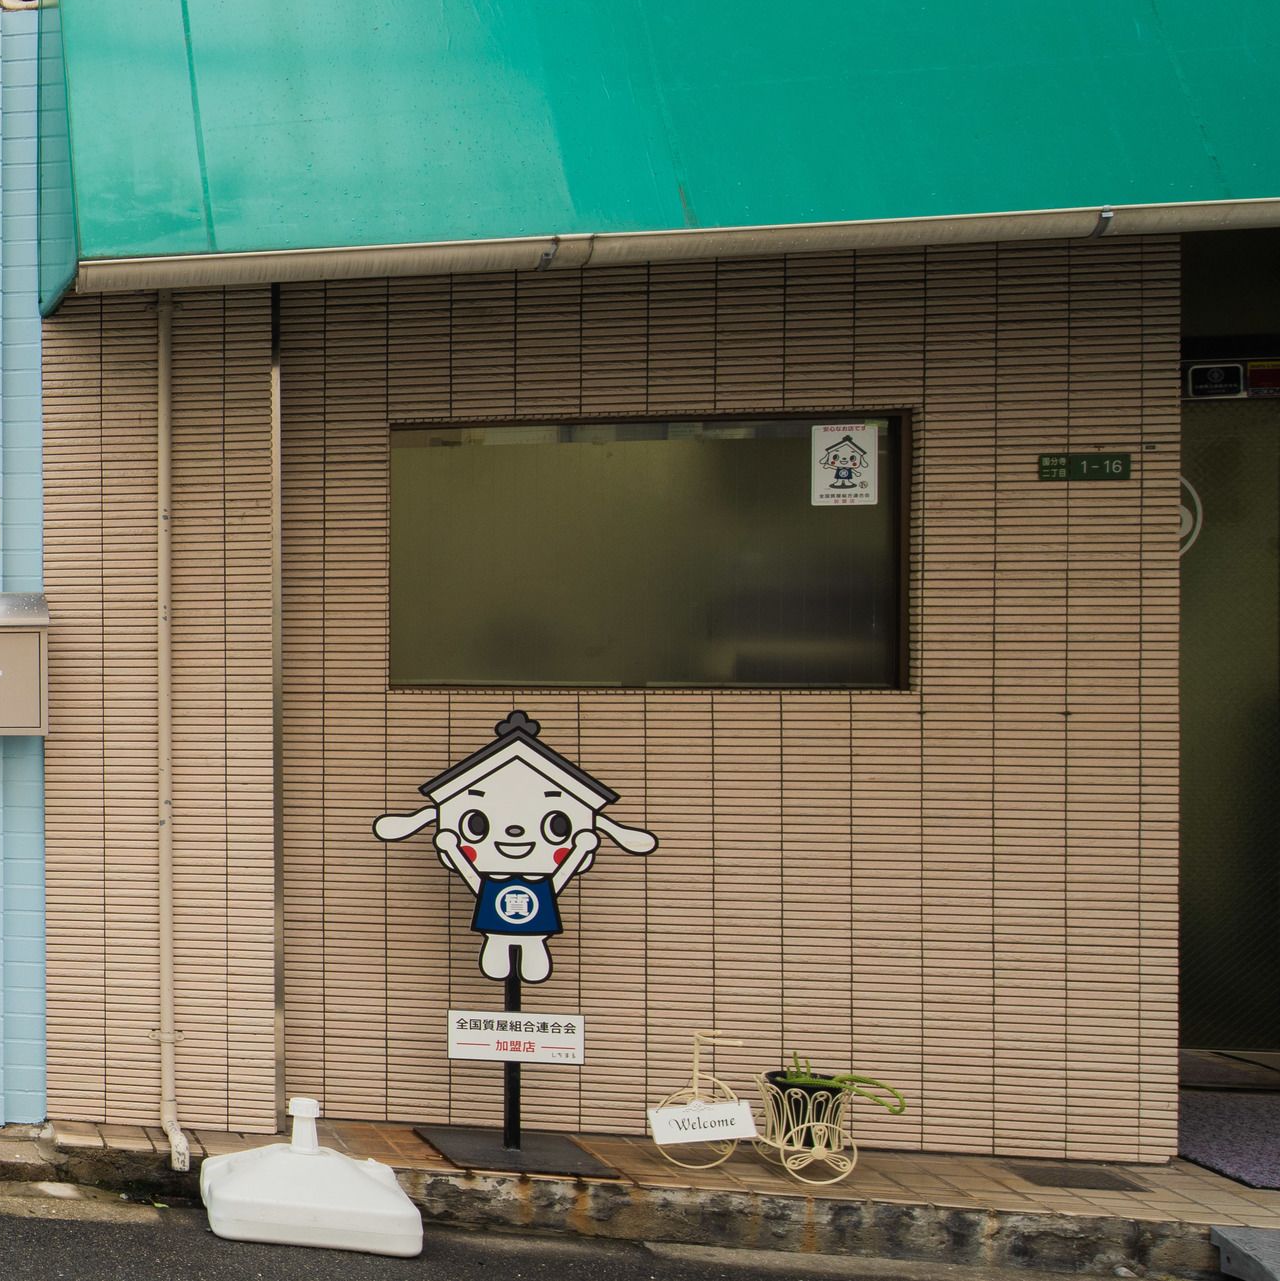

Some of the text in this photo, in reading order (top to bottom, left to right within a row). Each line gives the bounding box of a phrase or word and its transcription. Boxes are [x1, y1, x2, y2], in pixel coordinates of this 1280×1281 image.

[1042, 469, 1067, 478] 二丁目
[1081, 460, 1122, 474] 1-16
[456, 1017, 576, 1035] 全国質屋組合連合会
[495, 1040, 536, 1053] 加盟店
[669, 1117, 737, 1132] Welcome
